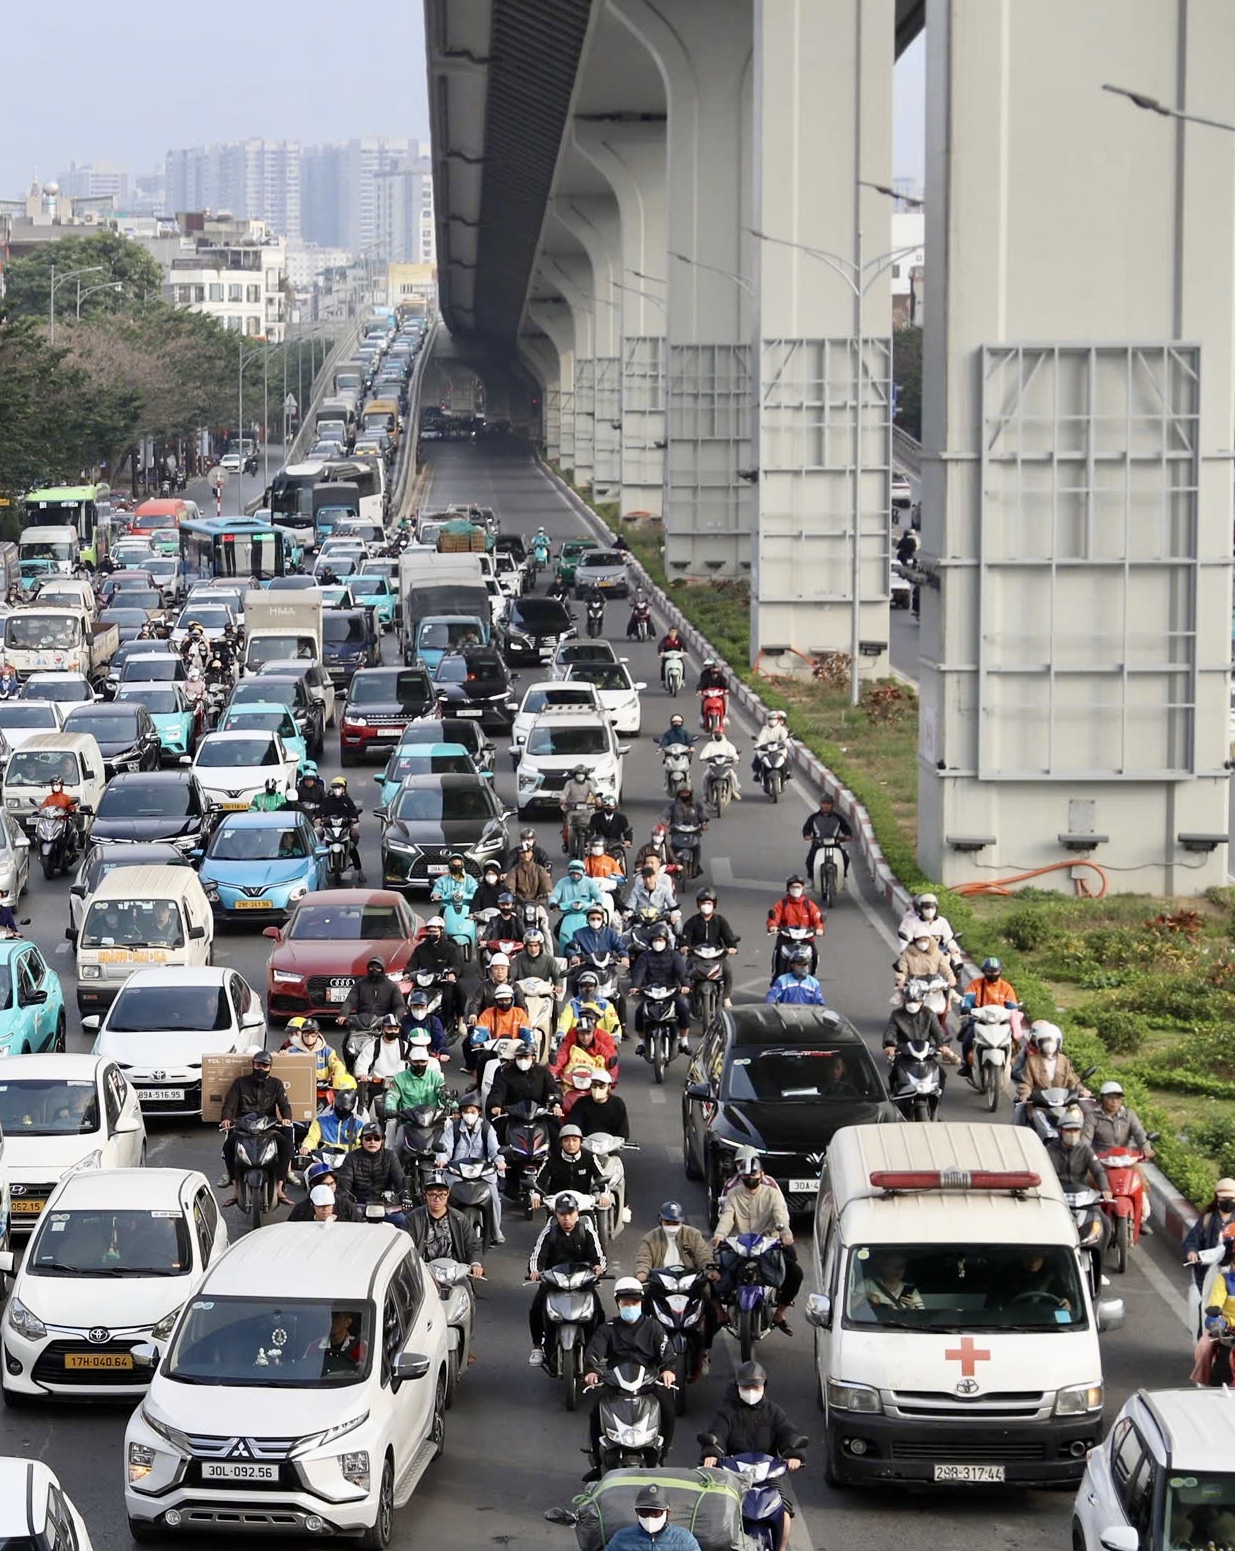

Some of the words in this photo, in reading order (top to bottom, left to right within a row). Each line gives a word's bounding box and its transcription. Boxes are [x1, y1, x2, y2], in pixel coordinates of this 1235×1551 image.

[269, 606, 295, 616] HMA
[138, 1091, 181, 1099] 89A-516.95
[72, 1356, 128, 1367] 17H-040.64
[208, 1465, 273, 1478] 30L-092.56
